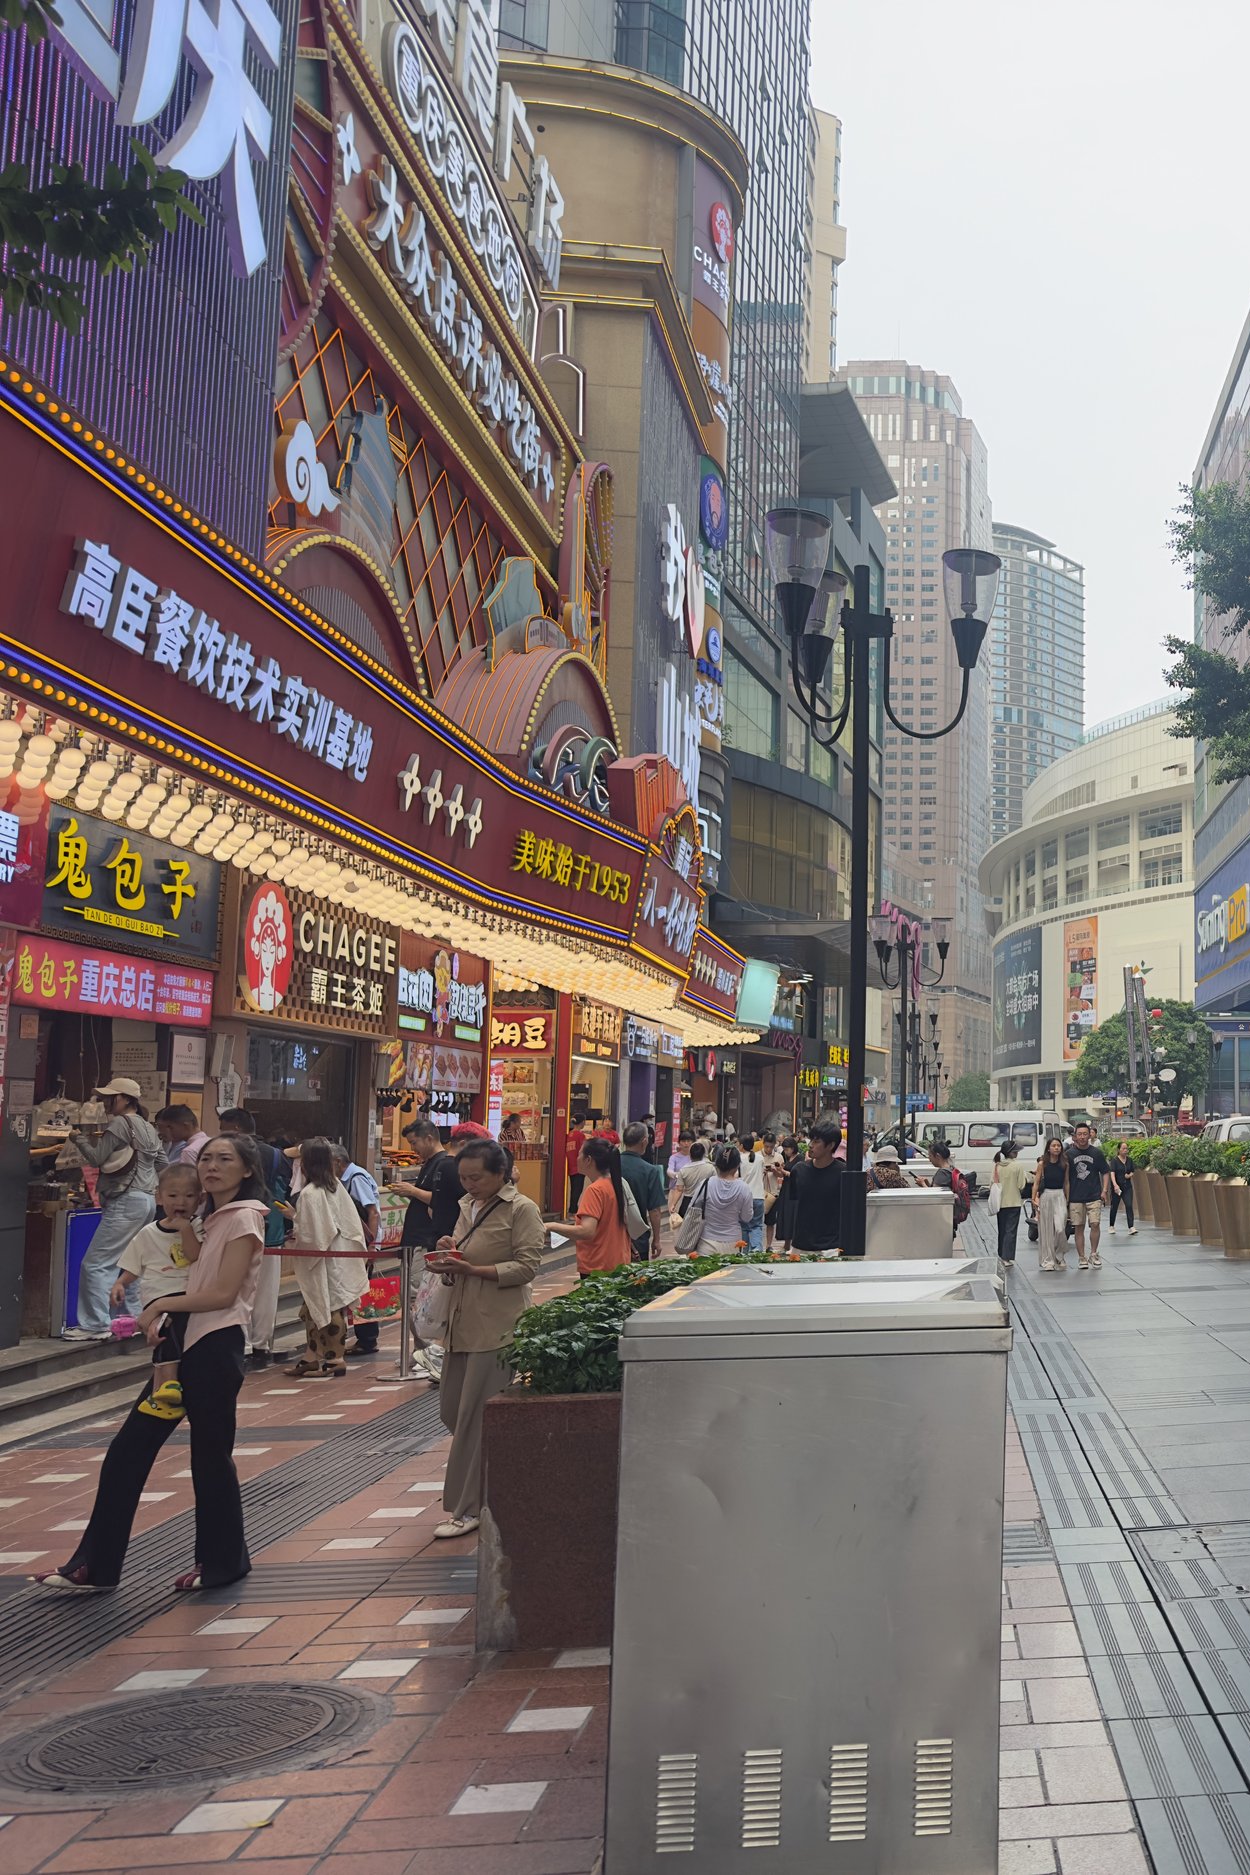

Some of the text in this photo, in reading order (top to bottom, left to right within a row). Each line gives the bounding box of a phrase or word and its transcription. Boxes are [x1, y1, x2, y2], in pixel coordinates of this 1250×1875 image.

[370, 158, 541, 490] 大众点评必吃街
[66, 537, 374, 783] 高臣餐饮技术实训基地
[46, 817, 196, 920] 鬼包子
[512, 829, 632, 904] 美味始于1953
[85, 908, 163, 937] TAN DE QI GUI BAO ZI
[300, 911, 397, 975] CHAGEE
[1228, 897, 1247, 942] Pro
[15, 944, 156, 1013] 鬼包子 重庆总店
[310, 967, 384, 1016] 霸王茶姬
